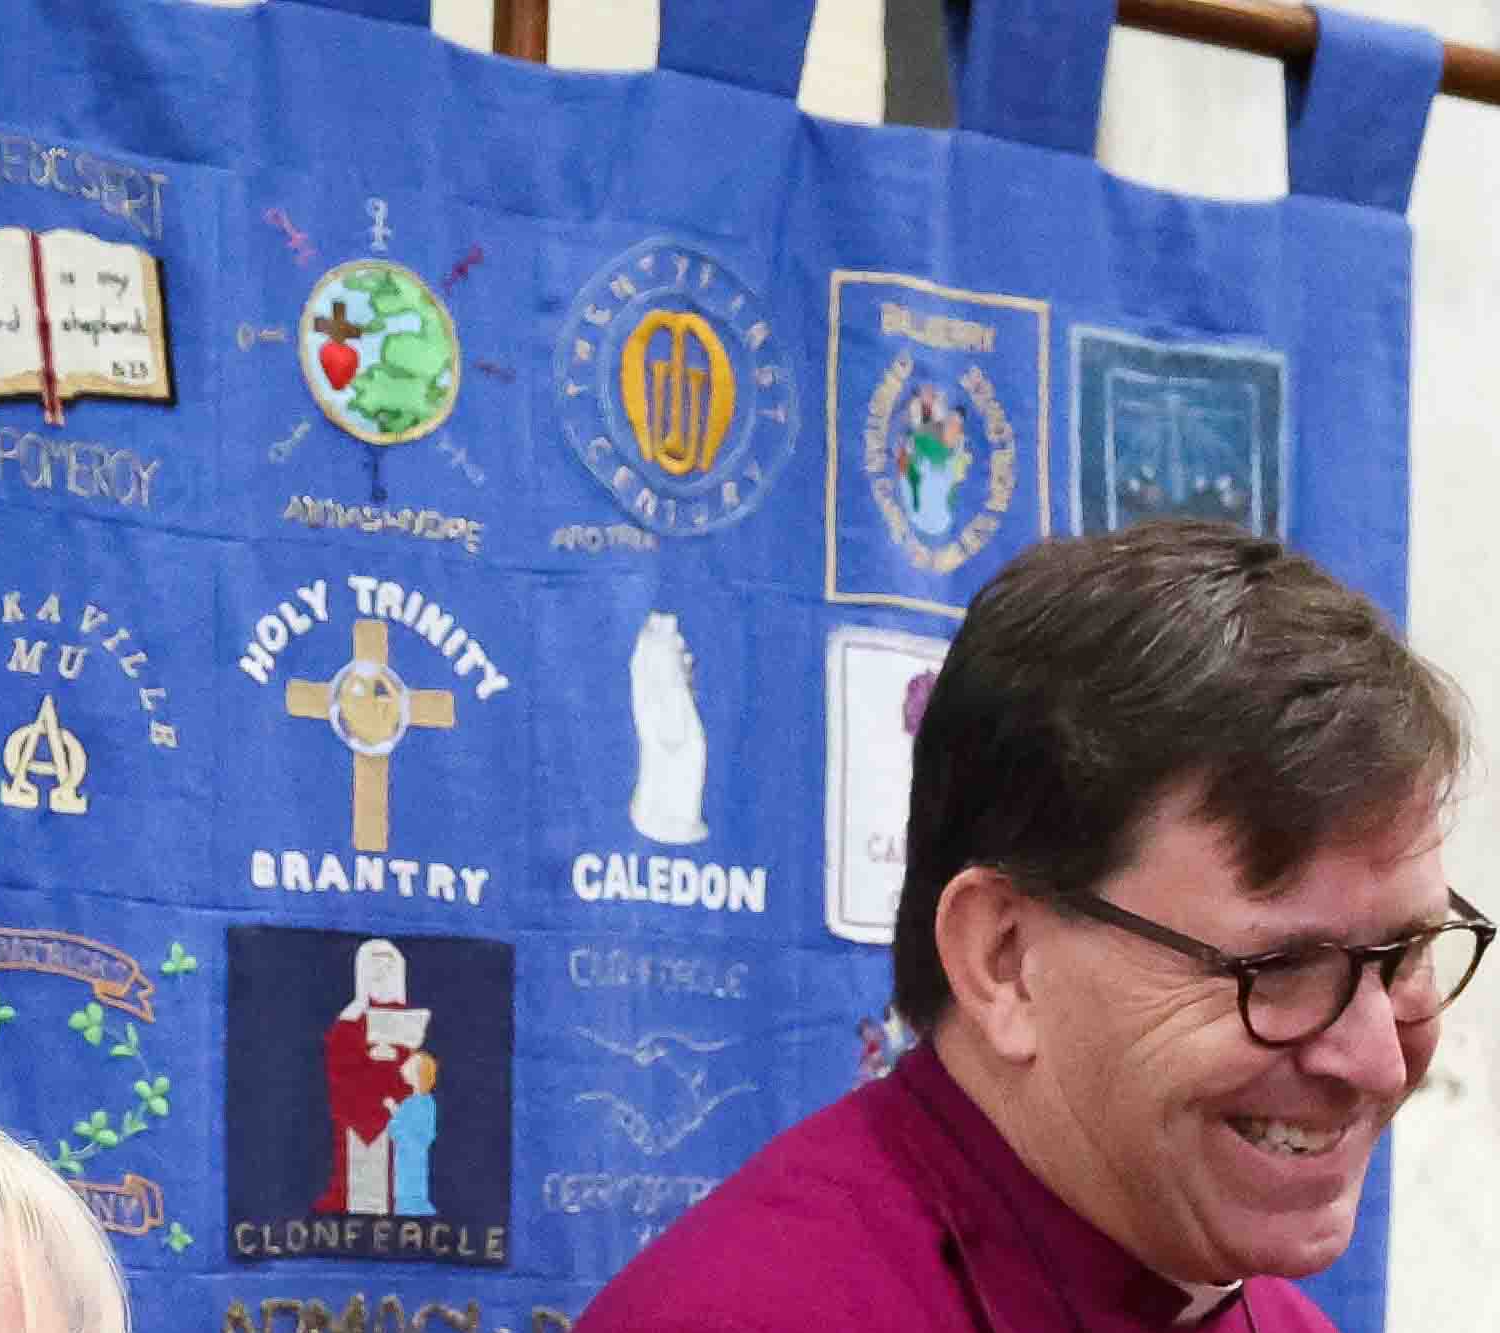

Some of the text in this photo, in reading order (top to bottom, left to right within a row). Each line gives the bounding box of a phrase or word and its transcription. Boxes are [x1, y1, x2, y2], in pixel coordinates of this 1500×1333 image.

[7, 638, 88, 681] MU
[239, 574, 510, 700] HOLY TRINITY
[250, 850, 490, 906] BRANTRY
[572, 853, 768, 914] CALEDON
[234, 1217, 506, 1260] CLONFEACLE
